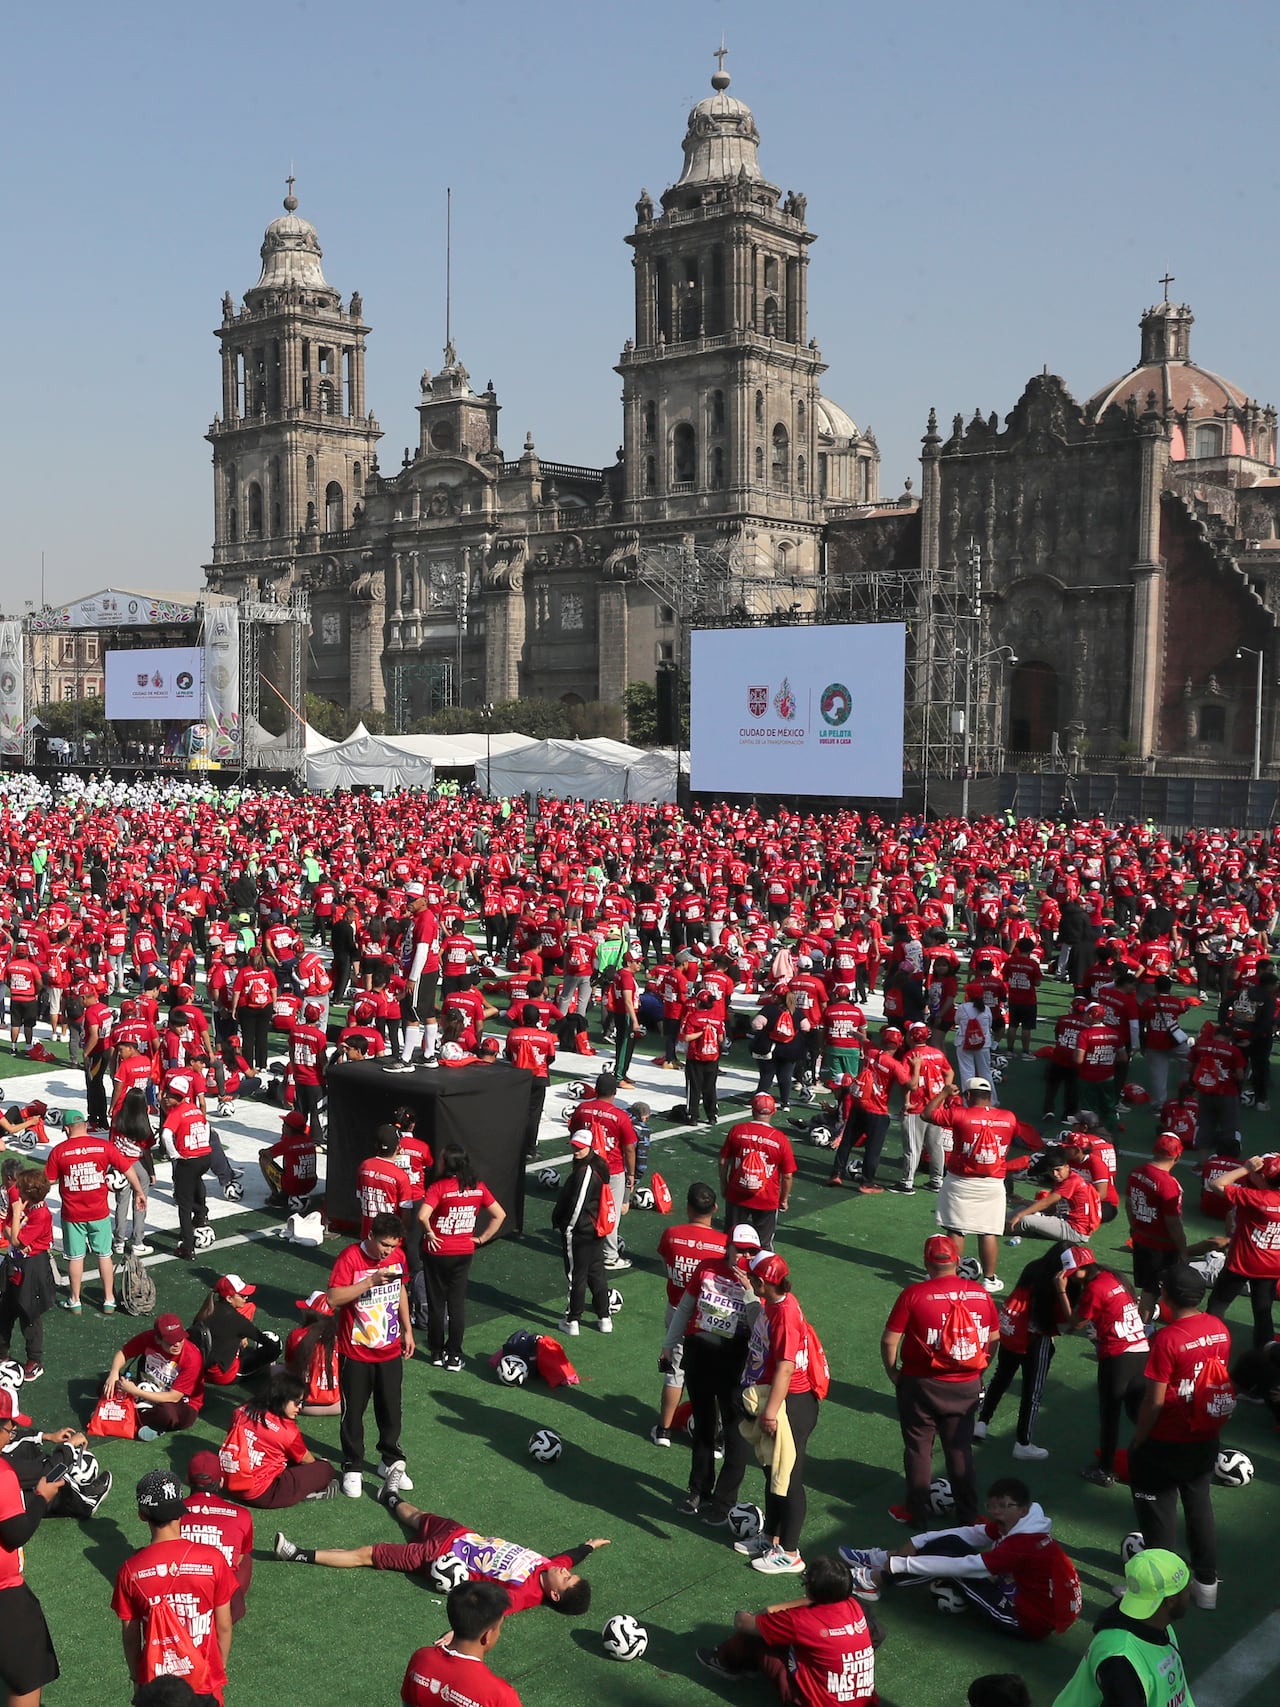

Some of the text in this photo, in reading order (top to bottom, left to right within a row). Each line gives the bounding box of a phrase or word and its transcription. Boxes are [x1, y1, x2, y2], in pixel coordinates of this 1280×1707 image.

[739, 726, 805, 737] CIUDAD DE MÉXICO
[449, 1210, 476, 1221] FUTBOL
[675, 1255, 684, 1264] LA
[373, 1283, 400, 1297] PELOTA
[707, 1315, 731, 1331] 4929
[181, 1524, 190, 1534] LA
[192, 1525, 217, 1536] CLASE
[842, 1653, 854, 1665] LA
[827, 1668, 855, 1694] MÁS
[838, 1688, 855, 1702] DEL
